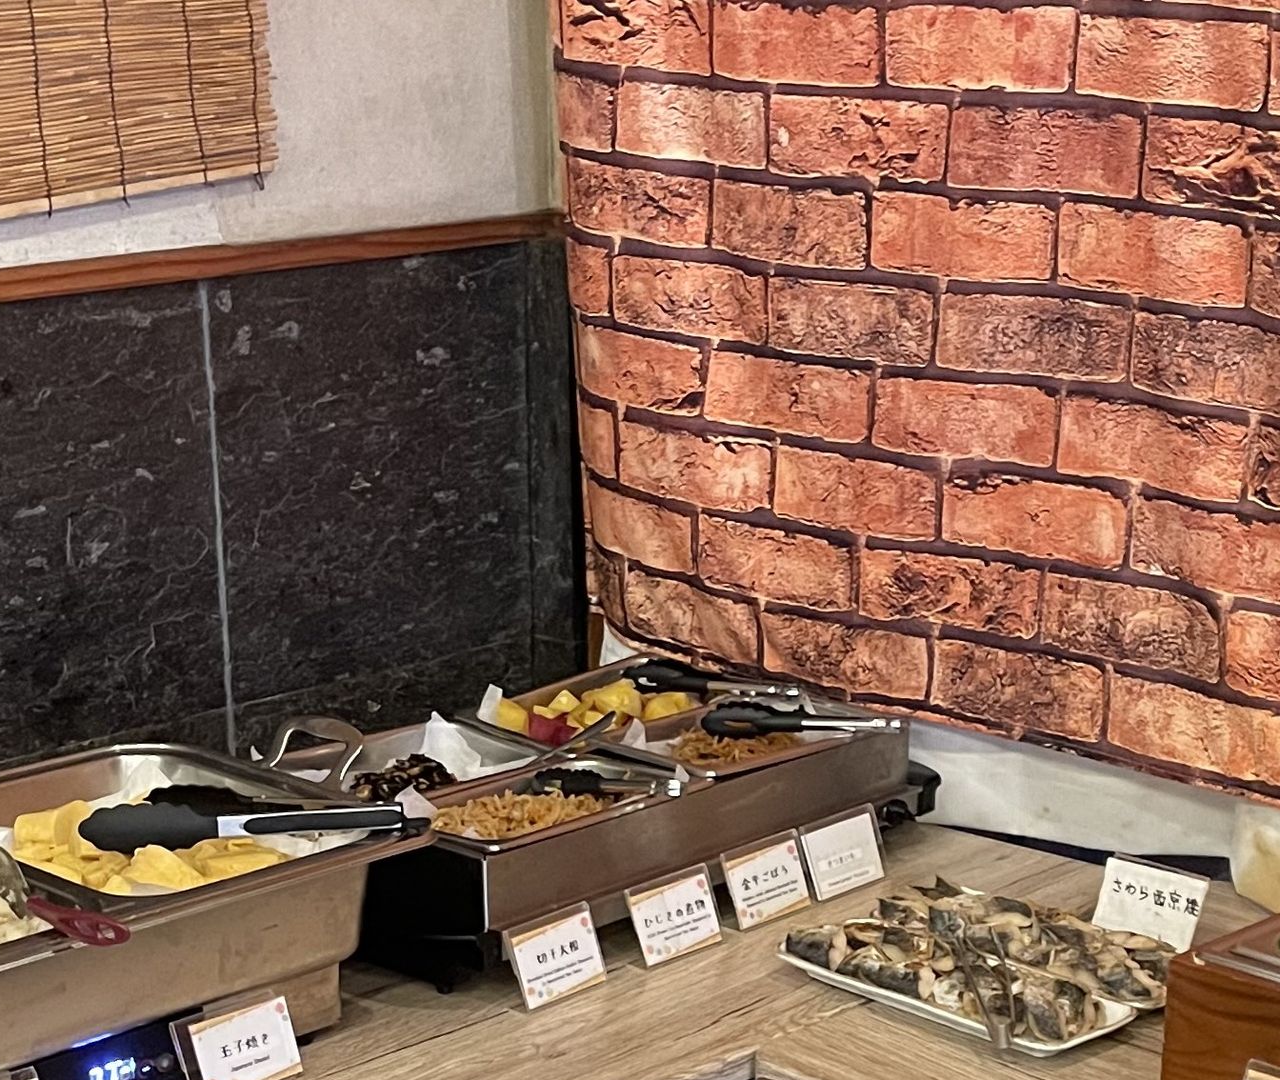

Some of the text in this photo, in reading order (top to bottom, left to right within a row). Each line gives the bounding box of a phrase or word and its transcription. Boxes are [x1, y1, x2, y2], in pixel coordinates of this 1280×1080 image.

[741, 864, 789, 891] 金平ごぼう
[643, 898, 706, 928] ひじきの煮物
[219, 1032, 269, 1059] 玉子焼き
